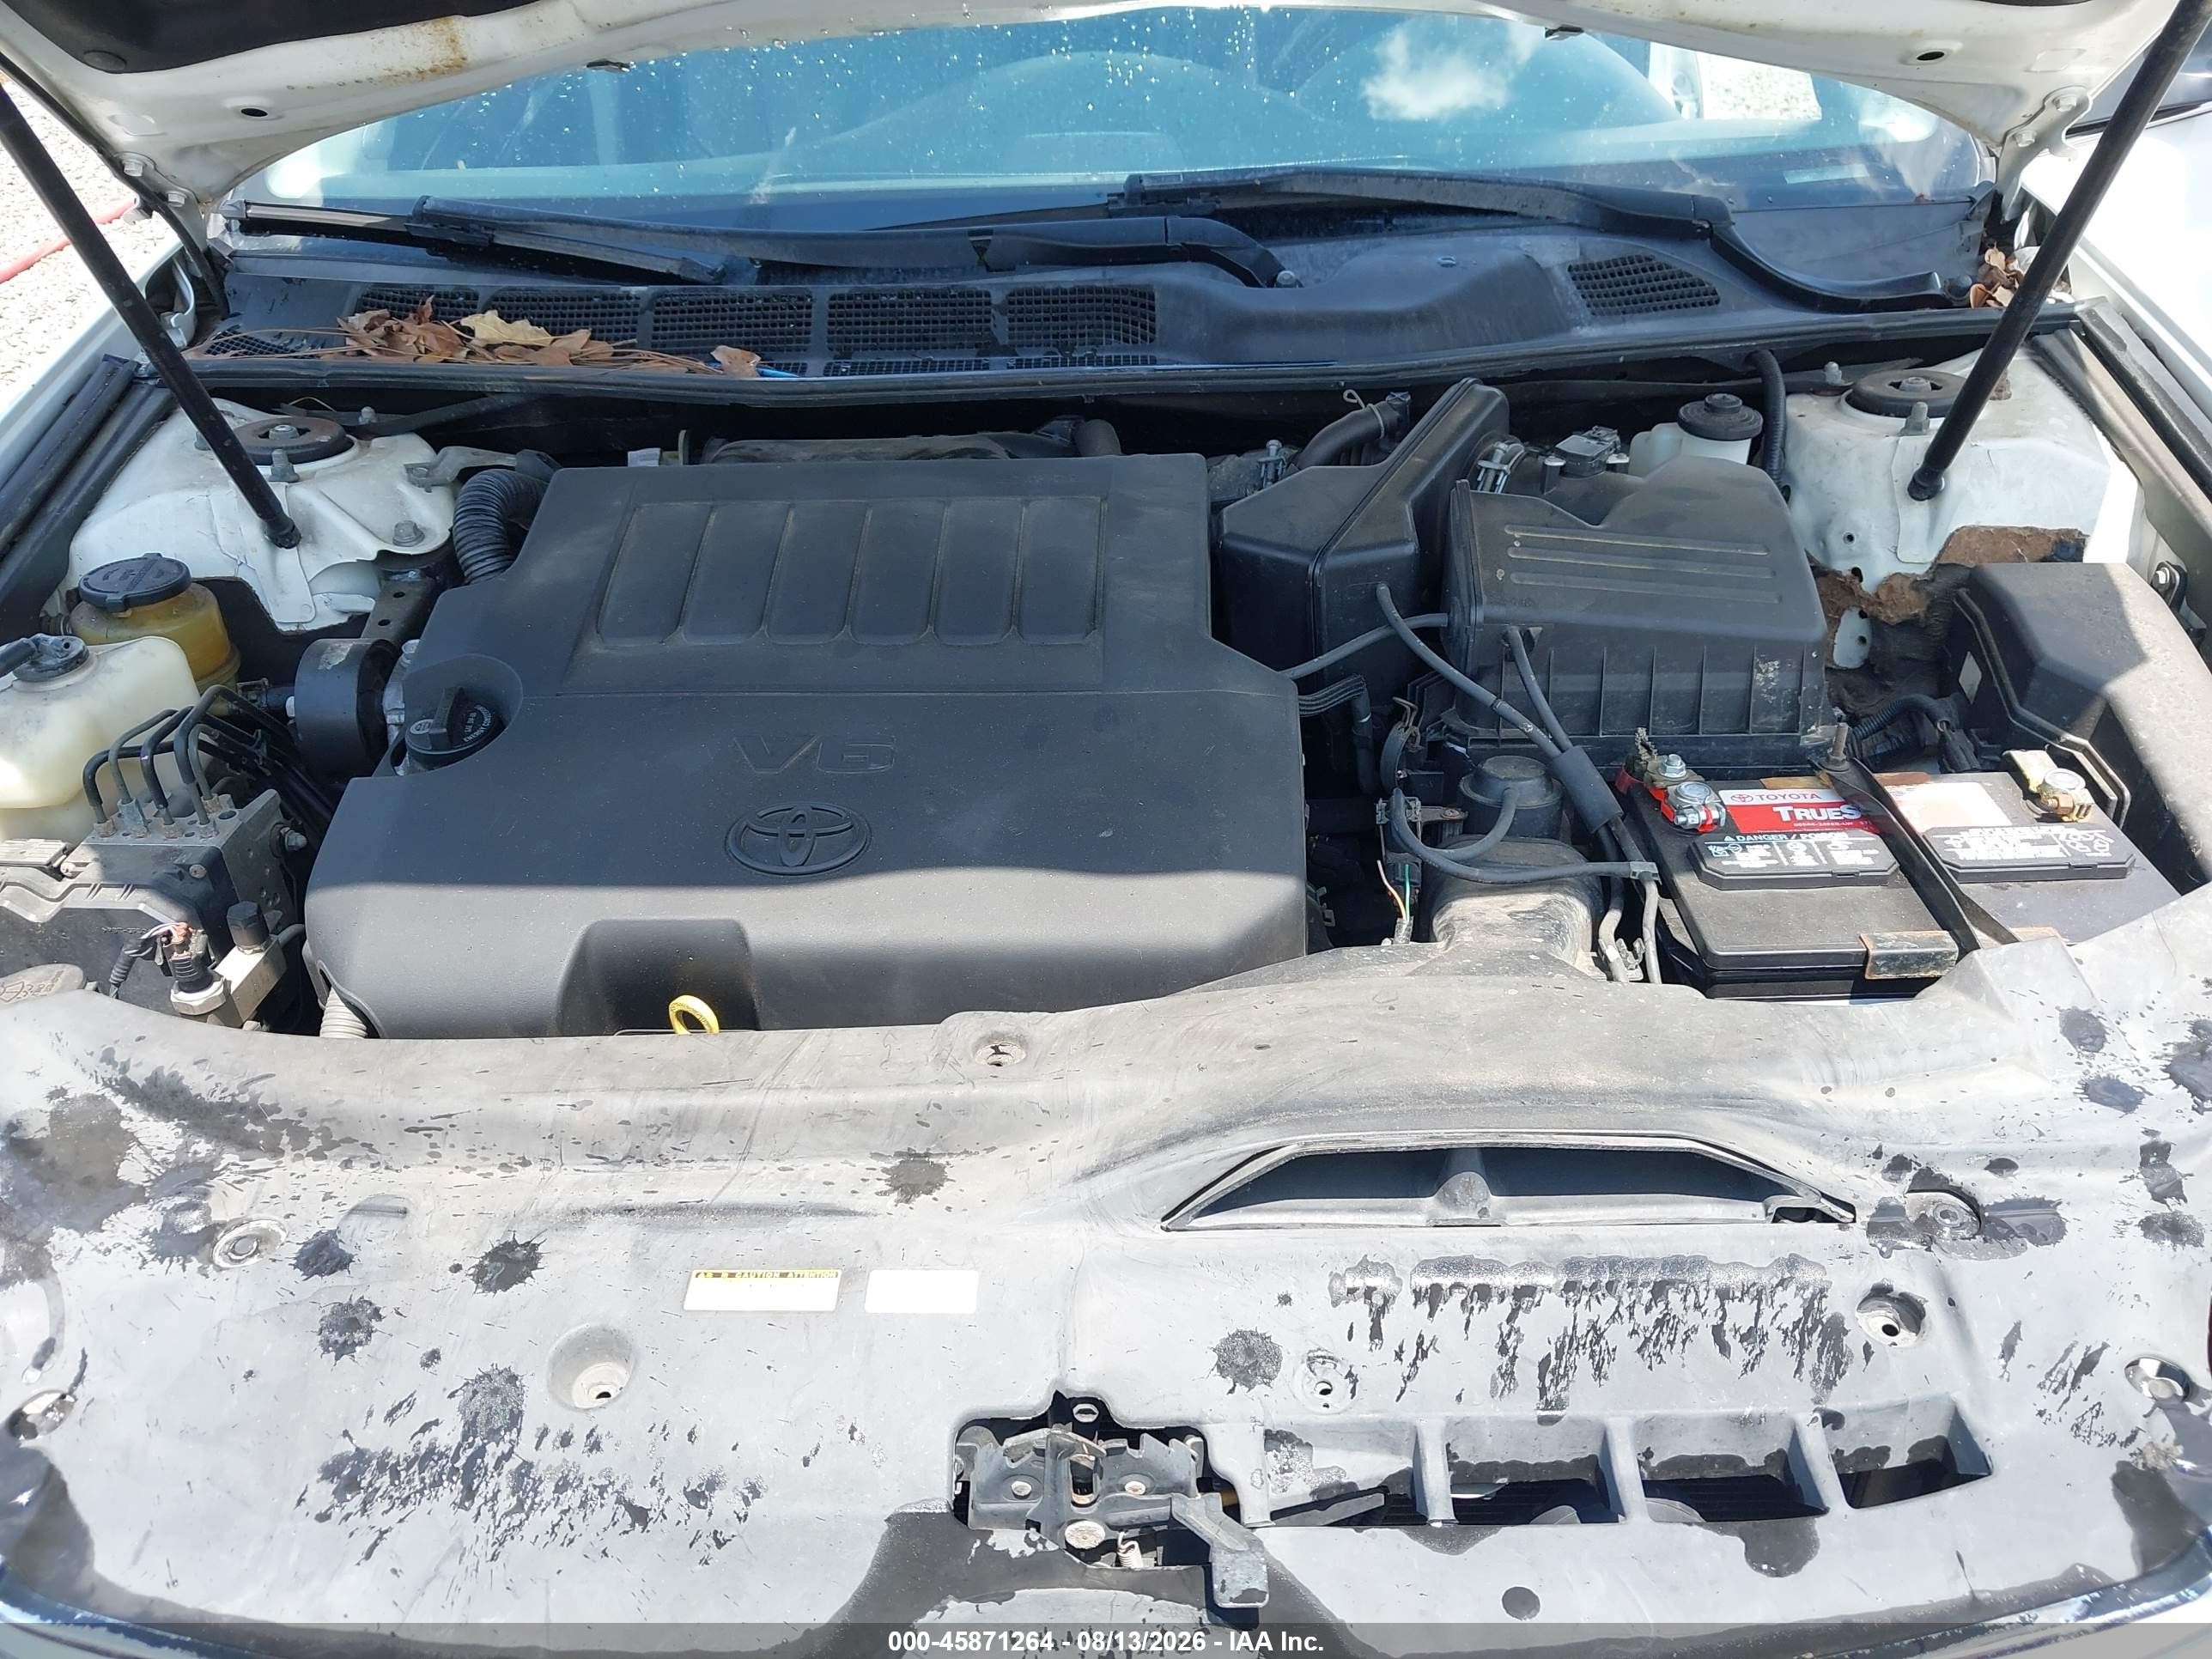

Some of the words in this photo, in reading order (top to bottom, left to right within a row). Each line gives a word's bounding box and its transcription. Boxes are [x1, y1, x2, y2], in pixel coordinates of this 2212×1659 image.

[732, 734, 896, 774] V6
[1756, 793, 1822, 801] TOYOTA
[1772, 804, 1862, 822] TRUES
